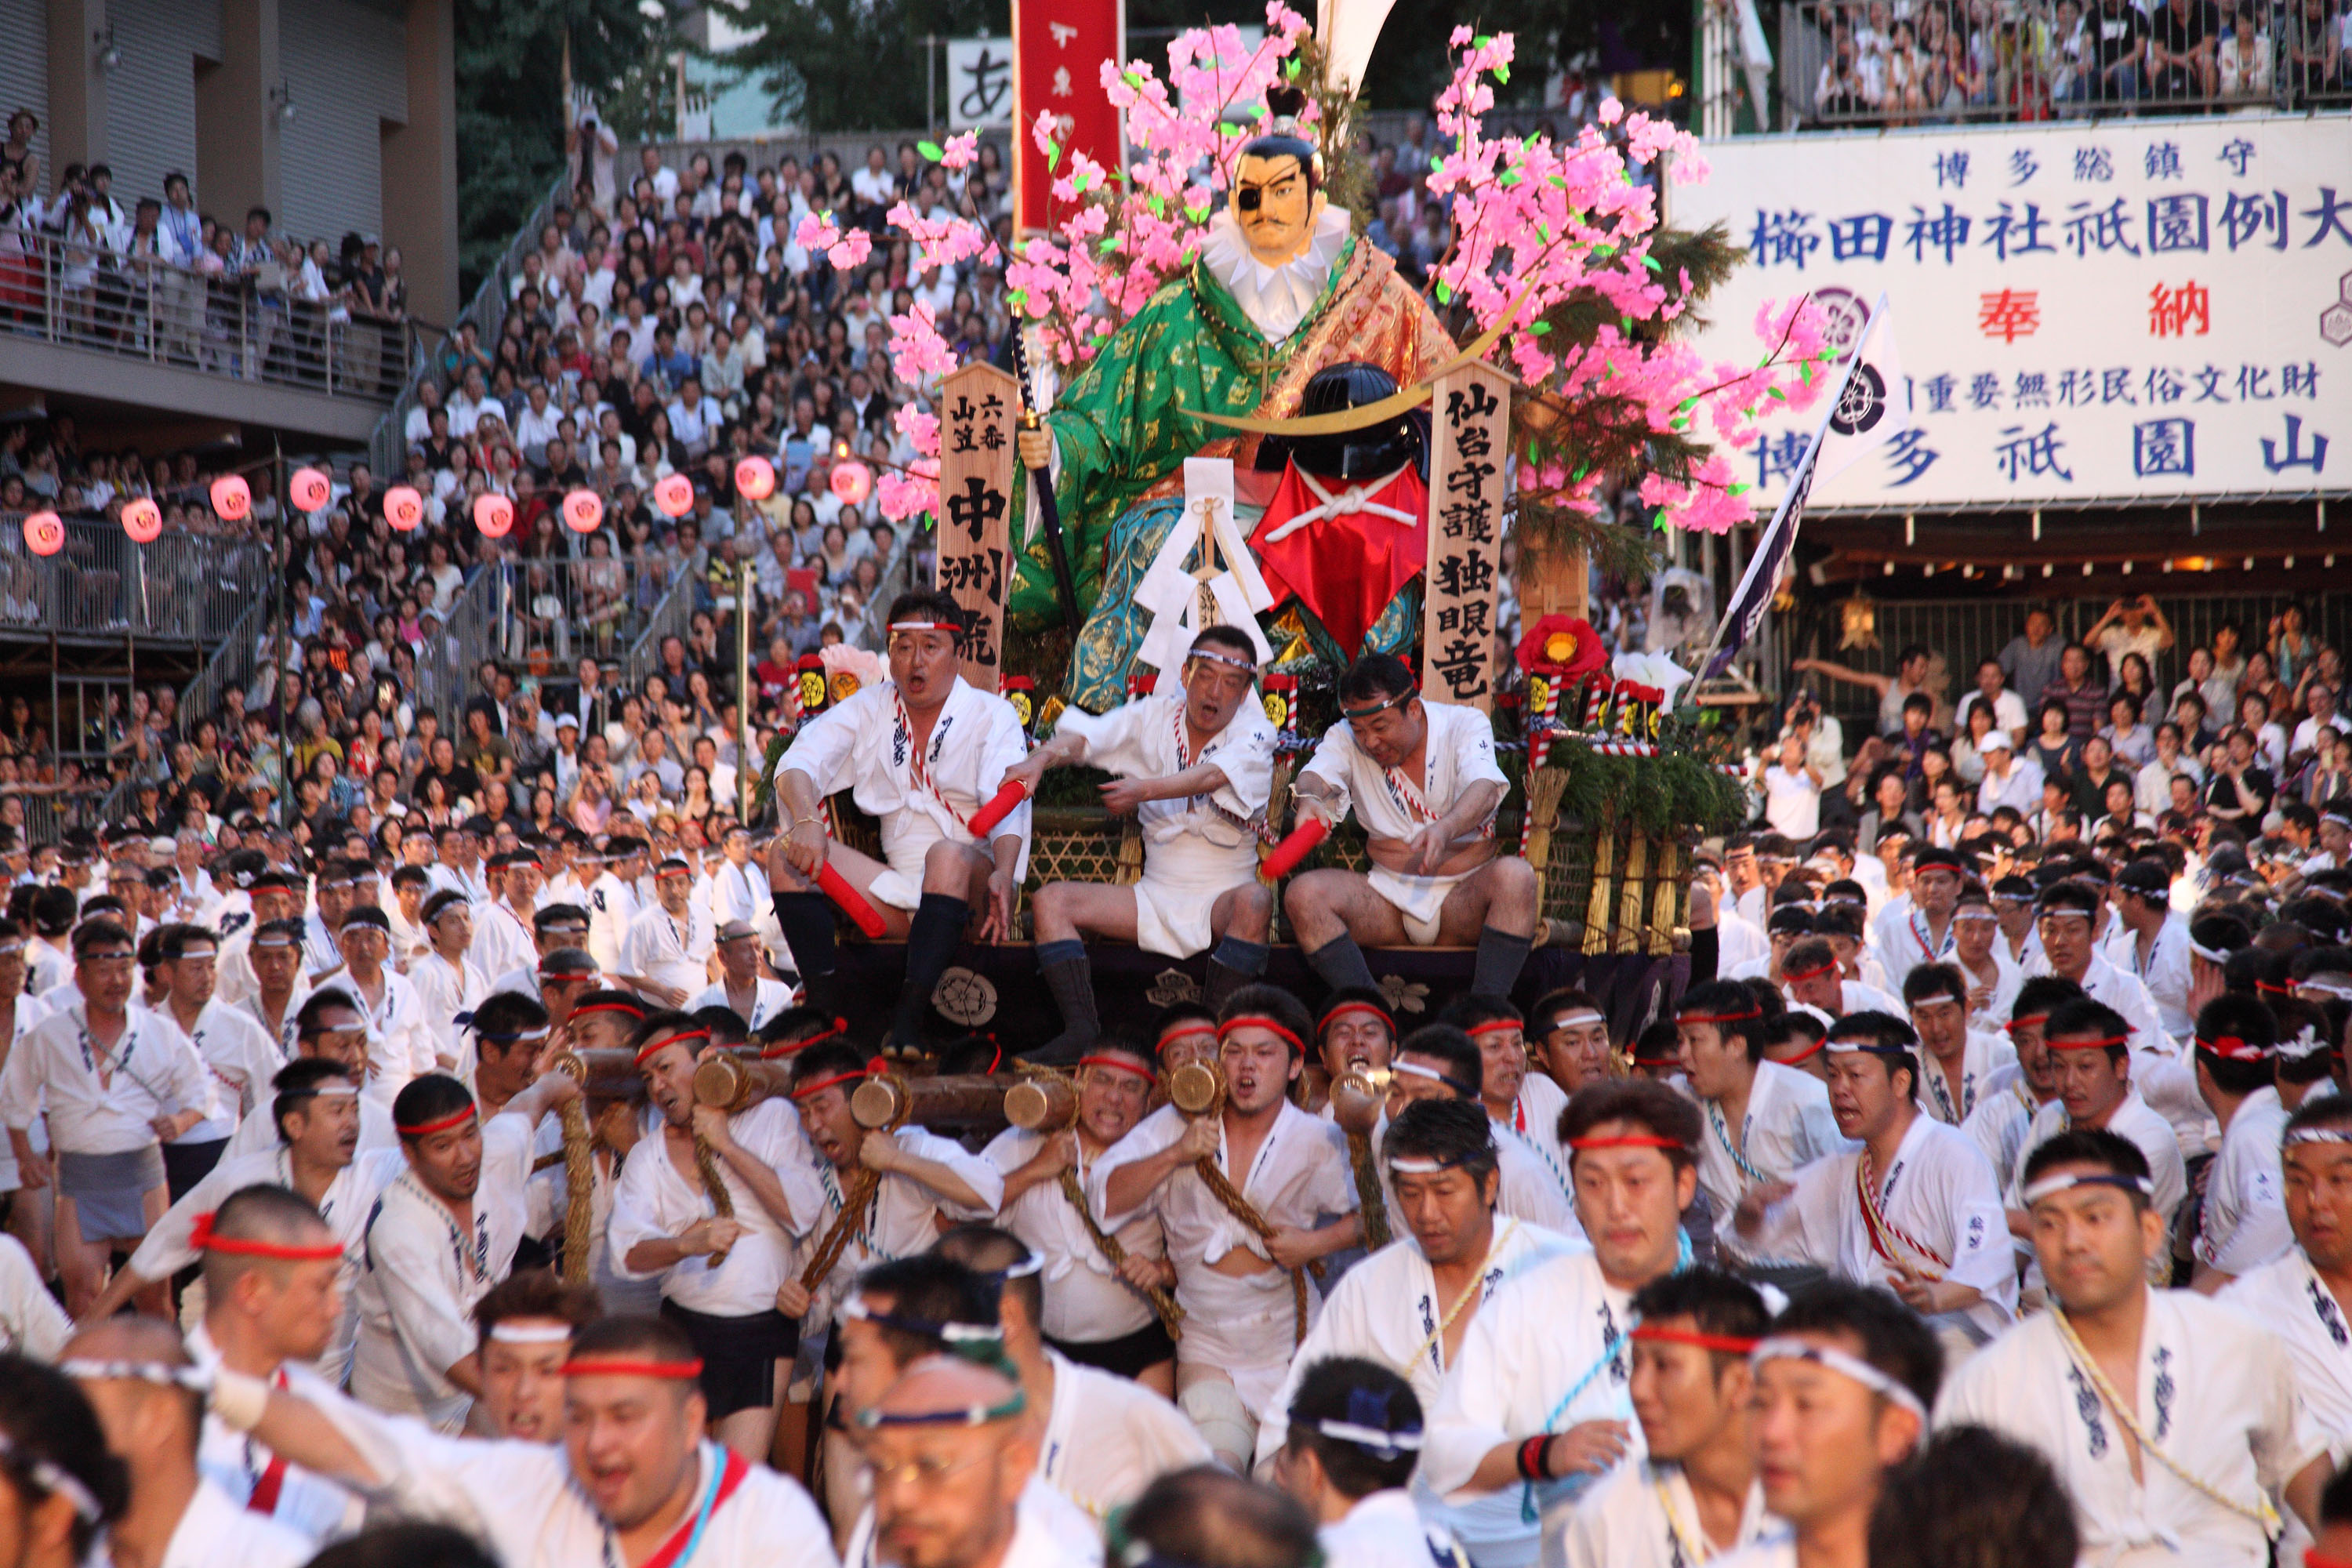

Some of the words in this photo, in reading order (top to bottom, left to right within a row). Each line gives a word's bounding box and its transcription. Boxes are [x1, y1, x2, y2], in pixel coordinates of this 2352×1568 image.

[958, 48, 1012, 120] あ
[1933, 136, 2258, 189] 博多総鎮守
[1978, 280, 2210, 345] 奉納
[1904, 361, 2321, 414] 重要無形民俗文化財
[949, 395, 979, 454] 山笠
[979, 394, 1007, 452] 六番
[1431, 382, 1498, 699] 仙台守護独眼竜
